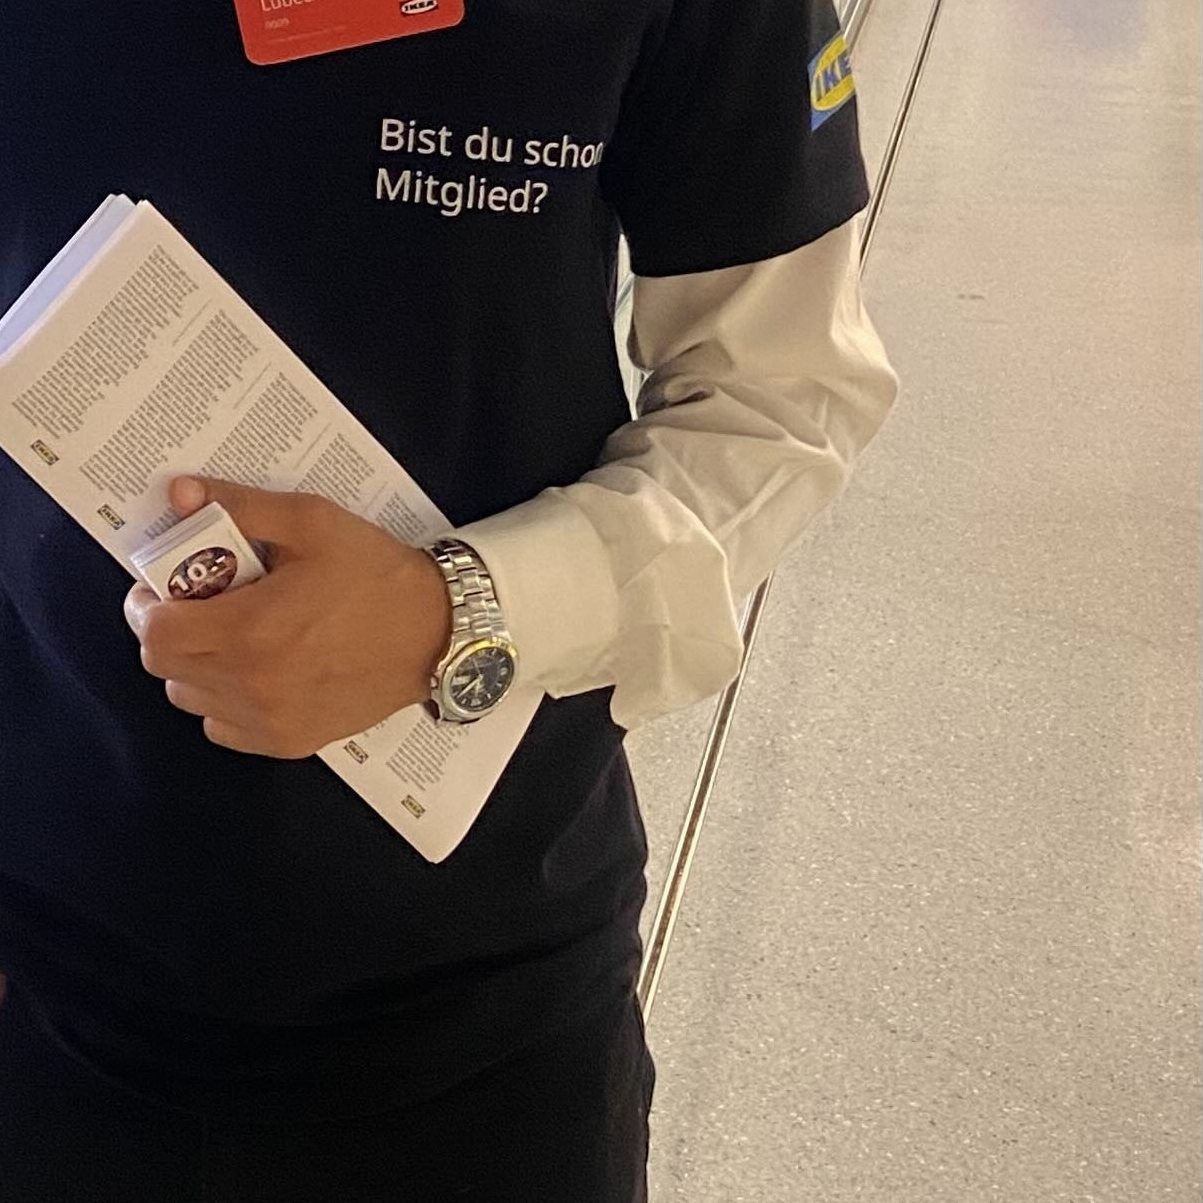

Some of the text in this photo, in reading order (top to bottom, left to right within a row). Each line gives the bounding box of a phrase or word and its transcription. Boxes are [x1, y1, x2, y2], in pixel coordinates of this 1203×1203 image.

[403, 0, 436, 13] IKEA
[380, 117, 453, 157] Bist
[464, 125, 512, 163] du
[375, 167, 549, 218] Mitglied?
